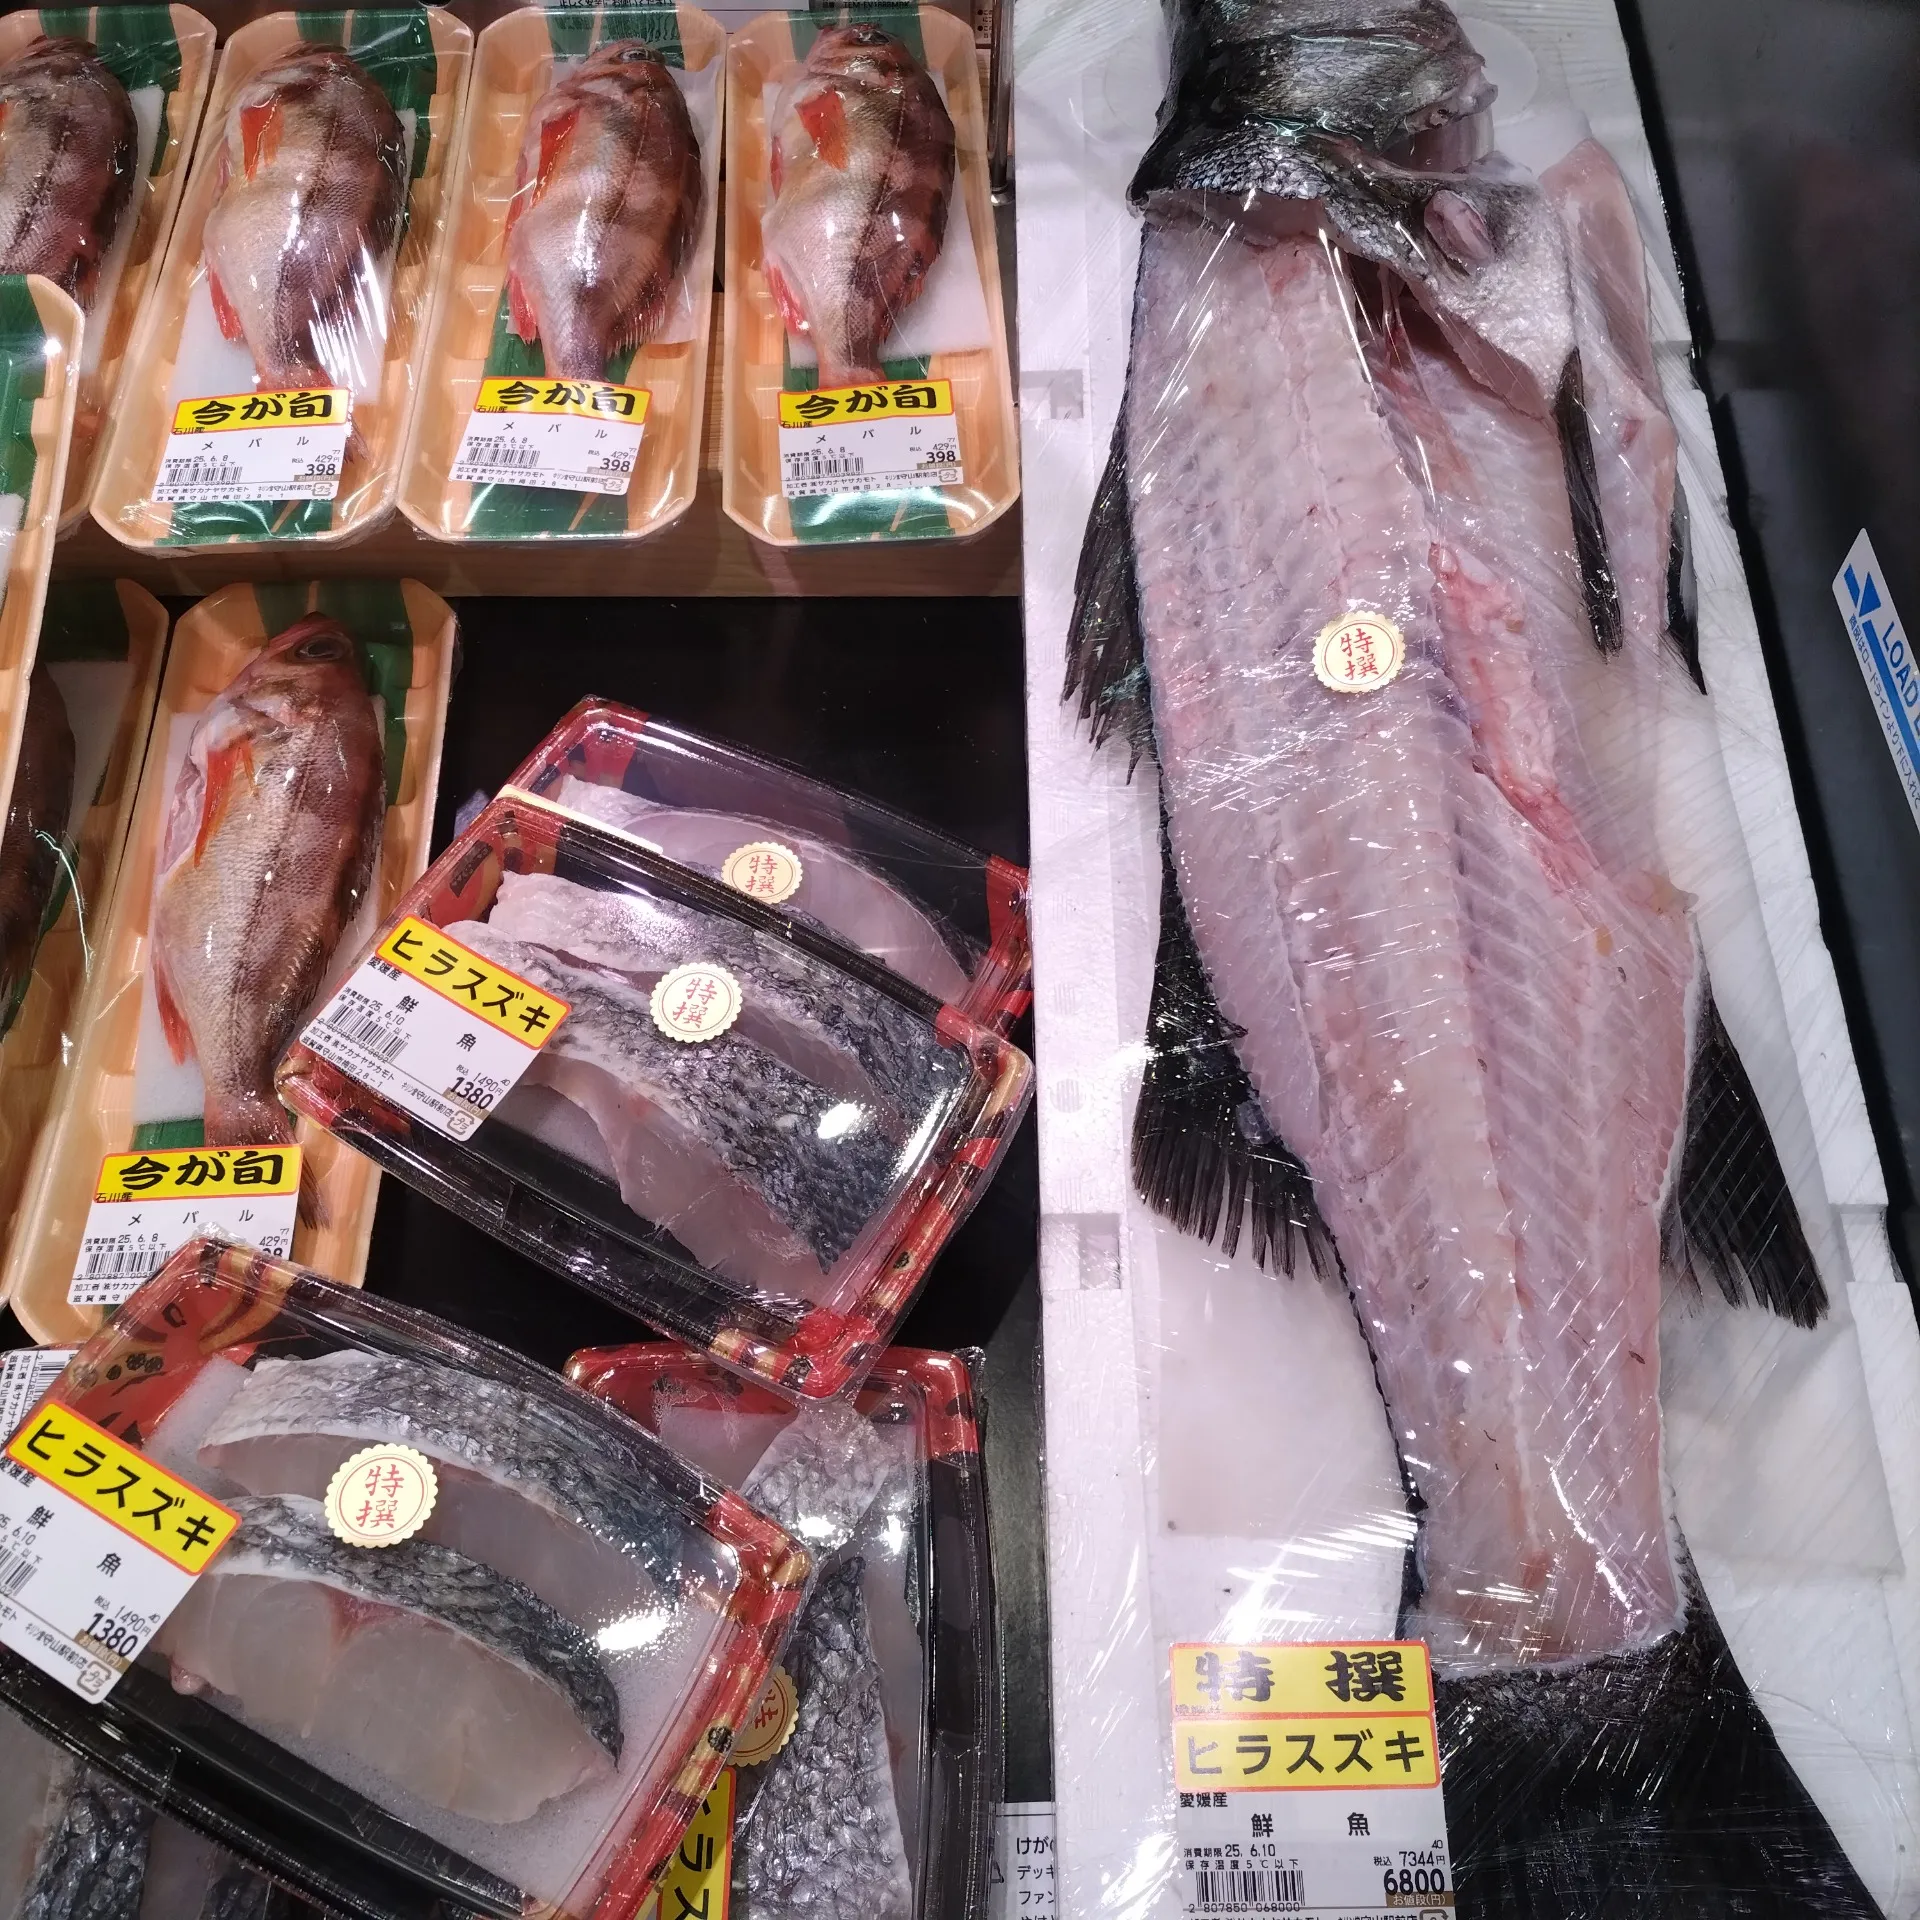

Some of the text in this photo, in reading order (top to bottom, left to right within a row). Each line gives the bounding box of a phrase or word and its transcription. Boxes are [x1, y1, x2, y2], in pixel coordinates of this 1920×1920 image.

[192, 392, 332, 424] 今が旬
[497, 381, 635, 416] 今が旬
[795, 385, 936, 419] 今が旬
[202, 437, 309, 450] メバル
[503, 422, 607, 439] メバル
[816, 427, 921, 443] メバル
[305, 464, 336, 476] 398
[600, 458, 630, 472] 398
[926, 451, 956, 463] 398
[1883, 621, 1919, 707] LOAD
[367, 957, 402, 981] 愛媛産
[391, 929, 550, 1033] ヒラスズキ
[450, 1077, 494, 1109] 1380
[119, 1151, 283, 1190] 今が旬
[128, 1210, 253, 1226] メバル
[26, 1419, 216, 1552] ヒラスズキ
[356, 1464, 404, 1528] 特撰
[86, 1612, 138, 1657] 1380
[1188, 1729, 1425, 1775] ヒラスズキ
[1180, 1792, 1228, 1808] 愛媛産
[1184, 1848, 1222, 1858] 消費期限
[1373, 1851, 1445, 1867] 税込 7344円
[1384, 1869, 1444, 1895] 6800
